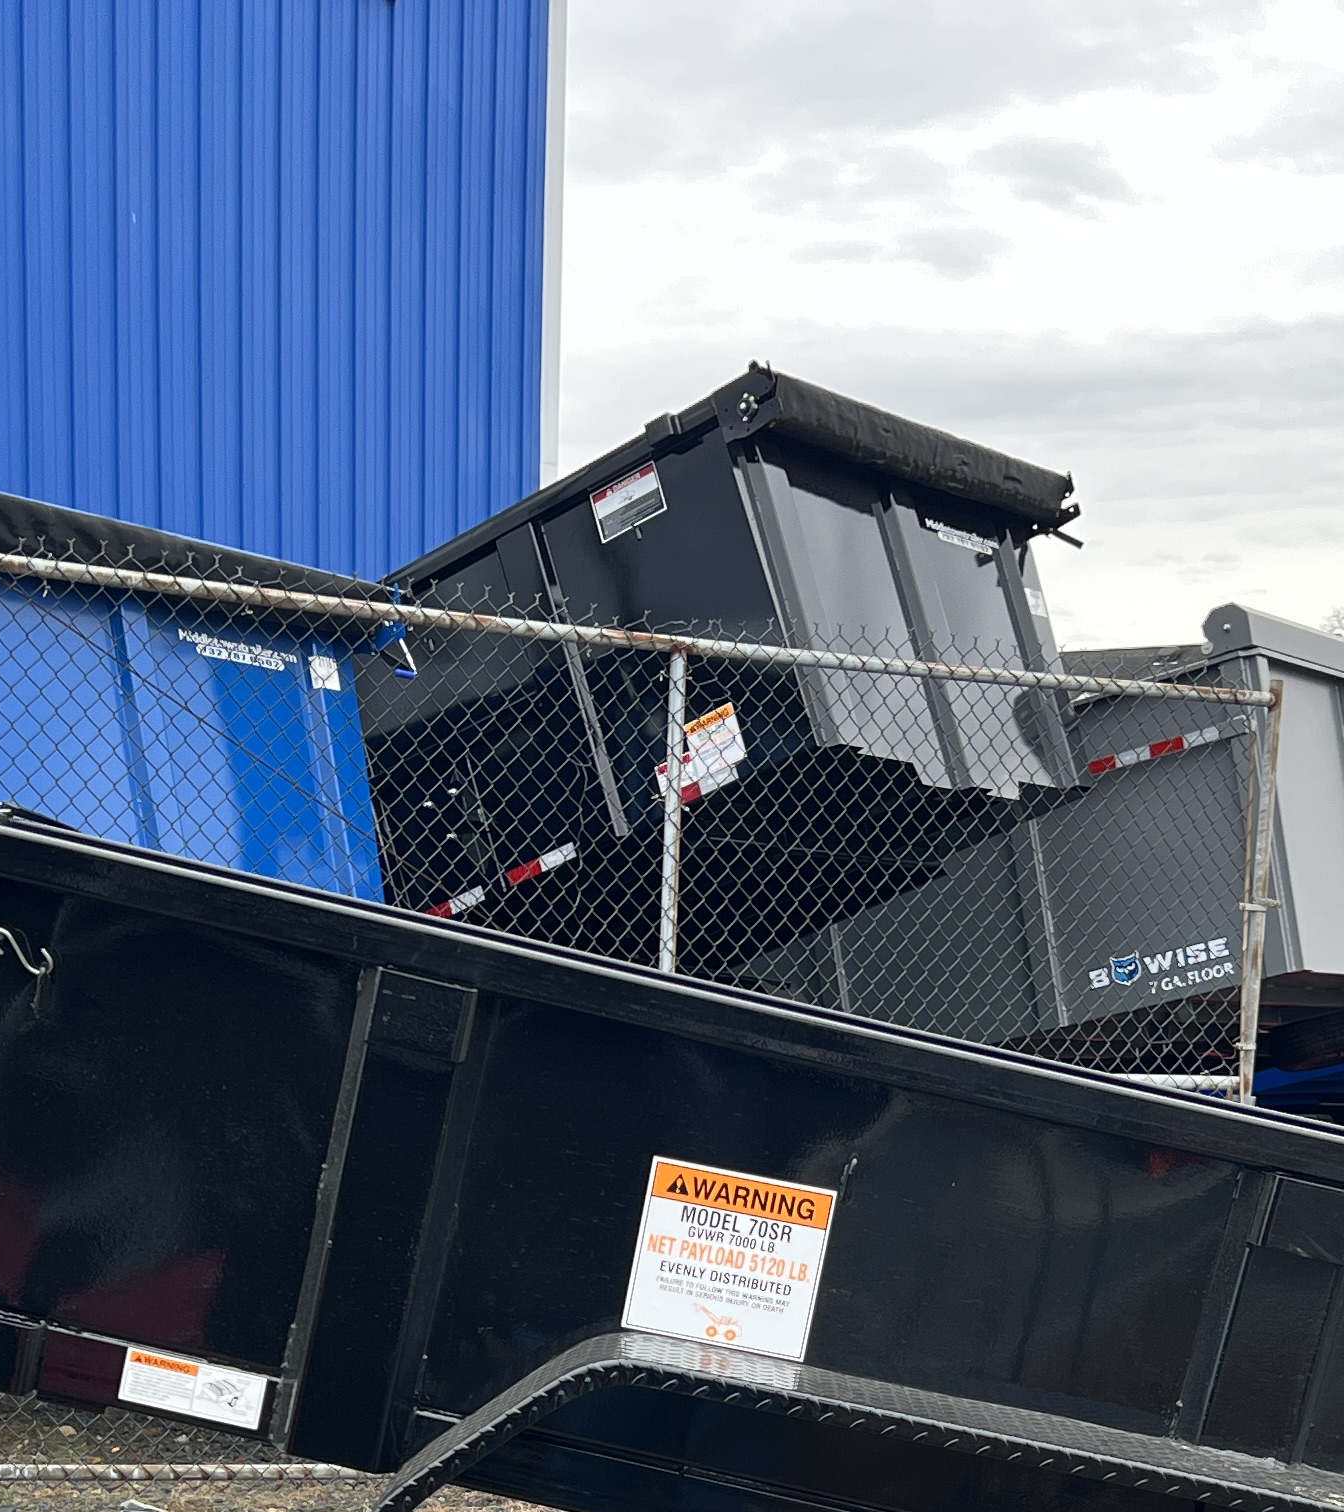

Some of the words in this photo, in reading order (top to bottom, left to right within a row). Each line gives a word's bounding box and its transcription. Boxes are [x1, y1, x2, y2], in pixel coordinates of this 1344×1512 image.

[1187, 962, 1235, 985] FLOOR
[693, 1176, 815, 1221] WARNING
[680, 1205, 741, 1234] MODEL
[748, 1218, 793, 1243] 70SR
[688, 1225, 724, 1243] GVWR
[729, 1234, 757, 1250] 7000
[647, 1233, 678, 1255] NET
[679, 1240, 746, 1270] PAYLOAD
[748, 1253, 786, 1278] 5120
[656, 1275, 685, 1288] FAILURE
[686, 1280, 694, 1288] TO
[696, 1282, 723, 1294] FOLLOW
[725, 1288, 740, 1298] THIS
[741, 1292, 774, 1305] WARNING
[775, 1299, 790, 1308] MAY
[659, 1260, 707, 1280] EVENLY
[709, 1270, 792, 1297] DISTRIBUTED
[659, 1284, 685, 1295] RESULT
[695, 1290, 724, 1303] SERIOUS
[725, 1297, 750, 1308] INJURY
[762, 1304, 785, 1315] DEATH
[144, 1357, 191, 1374] WARNING
